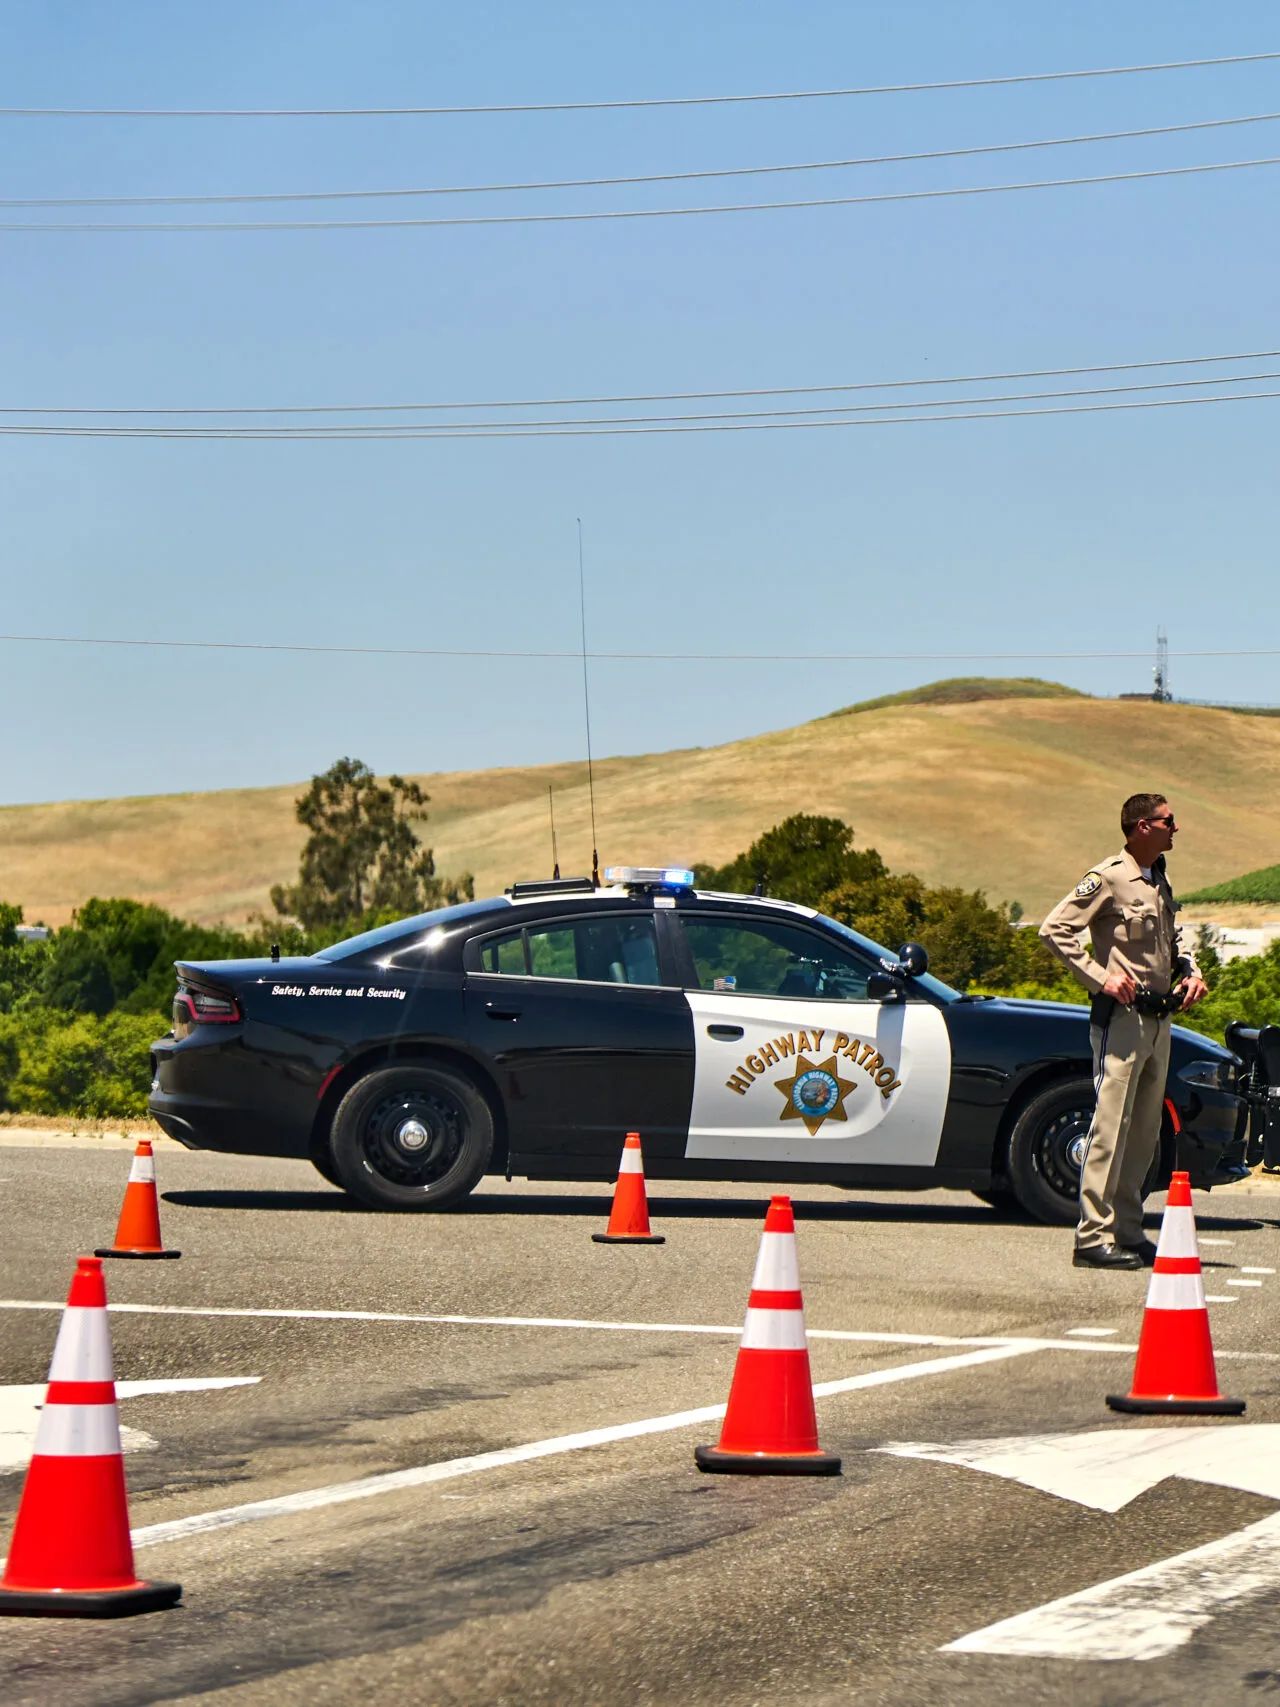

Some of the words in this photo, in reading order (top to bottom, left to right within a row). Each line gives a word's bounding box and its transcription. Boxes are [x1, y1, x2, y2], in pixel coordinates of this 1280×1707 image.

[271, 985, 306, 997] Safety,
[308, 986, 343, 997] Service
[345, 986, 364, 997] and
[367, 987, 407, 1000] Security
[725, 1029, 825, 1096] HIGHWAY
[832, 1031, 902, 1099] PATROL
[808, 1071, 836, 1086] HIGHWAY
